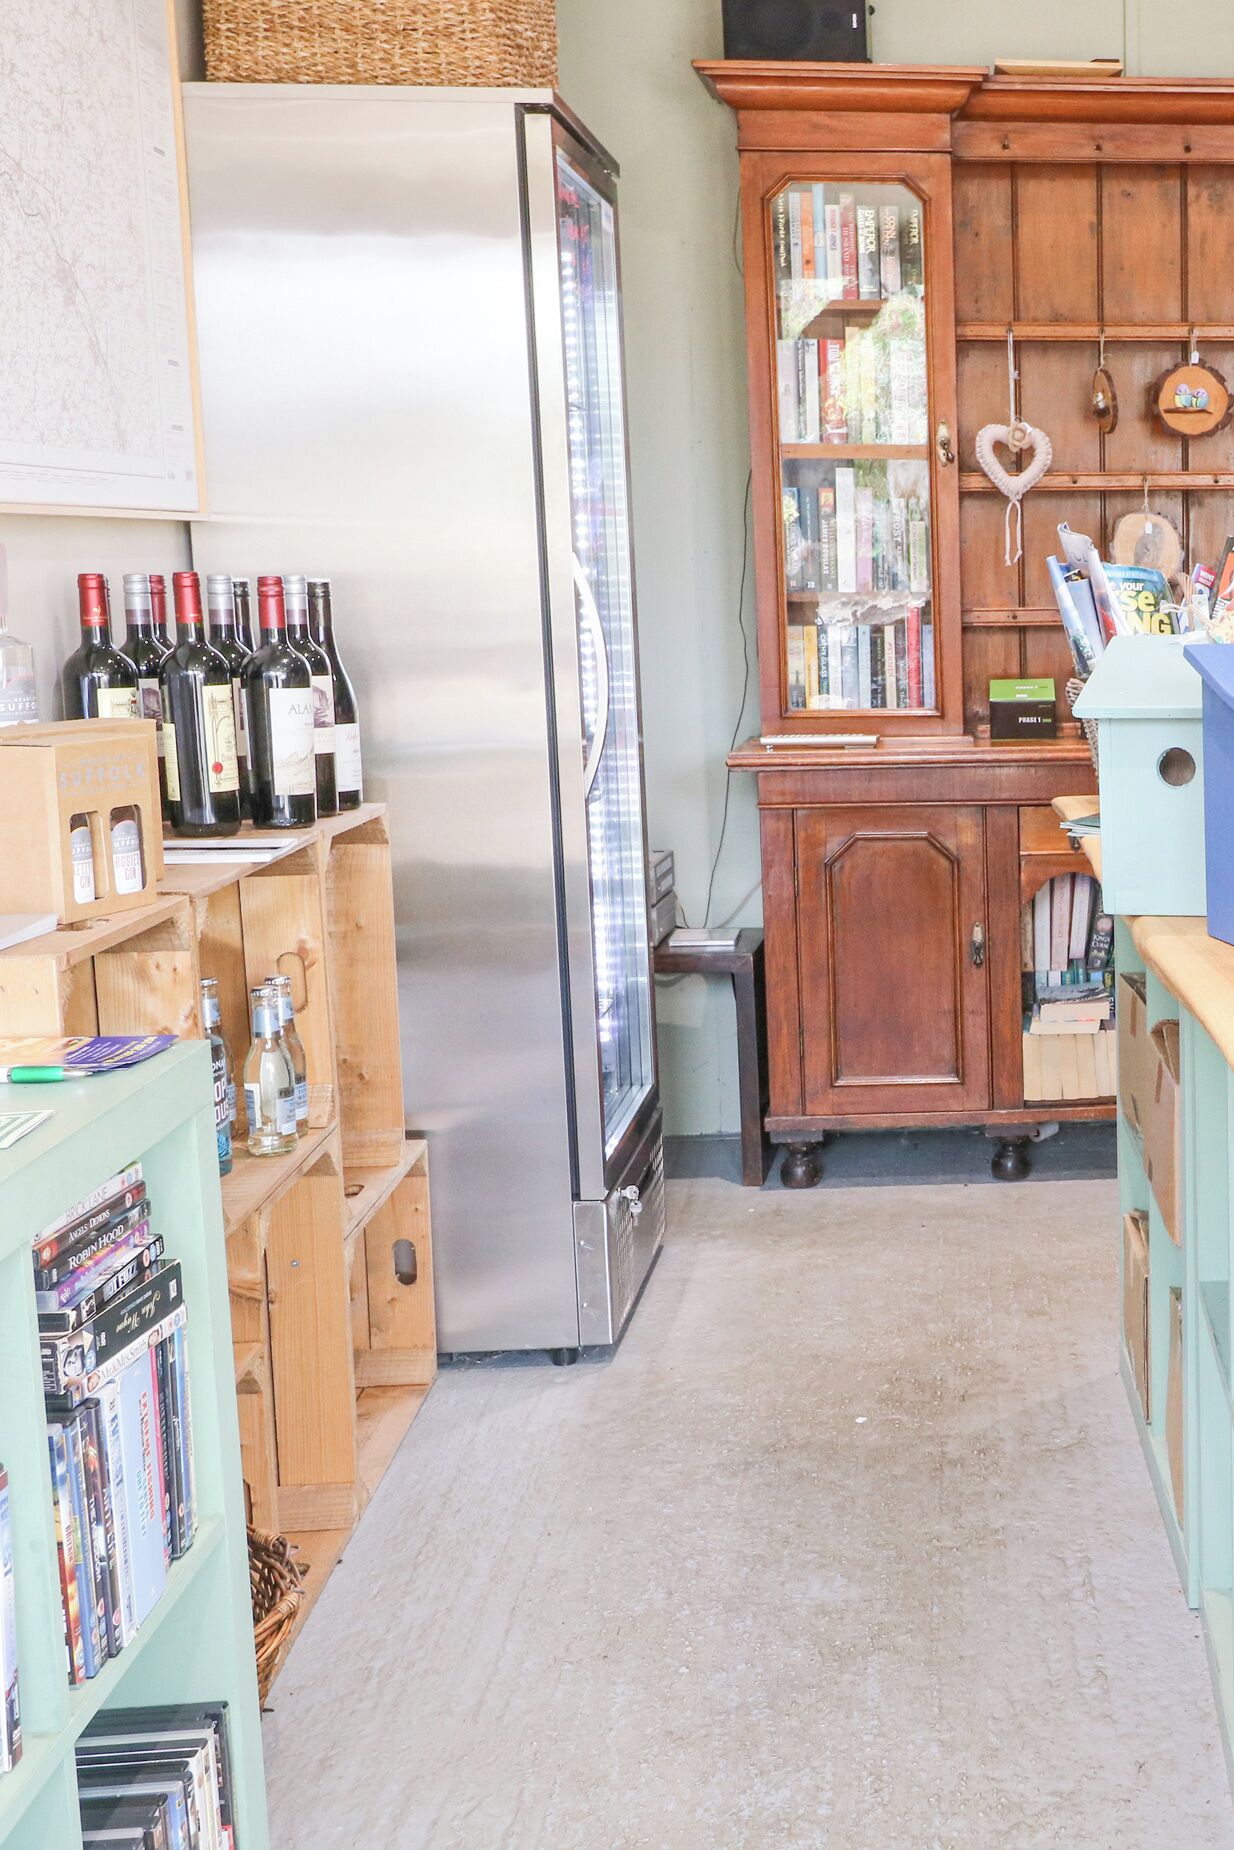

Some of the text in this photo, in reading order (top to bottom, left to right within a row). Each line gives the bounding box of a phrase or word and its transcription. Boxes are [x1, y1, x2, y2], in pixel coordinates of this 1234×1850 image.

[864, 209, 876, 254] EMPEROR
[909, 209, 919, 244] EMPEROR
[892, 511, 901, 542] FROST
[1119, 582, 1145, 592] your
[60, 762, 145, 790] SUFFOLK
[68, 1208, 111, 1242] ANGELS DEMONS
[67, 1224, 125, 1270] ROBIN HOOD
[119, 1261, 138, 1287] FUZZ
[141, 1391, 155, 1521] EXTREME FISHING
[88, 1495, 102, 1583] THE KINGDOM
